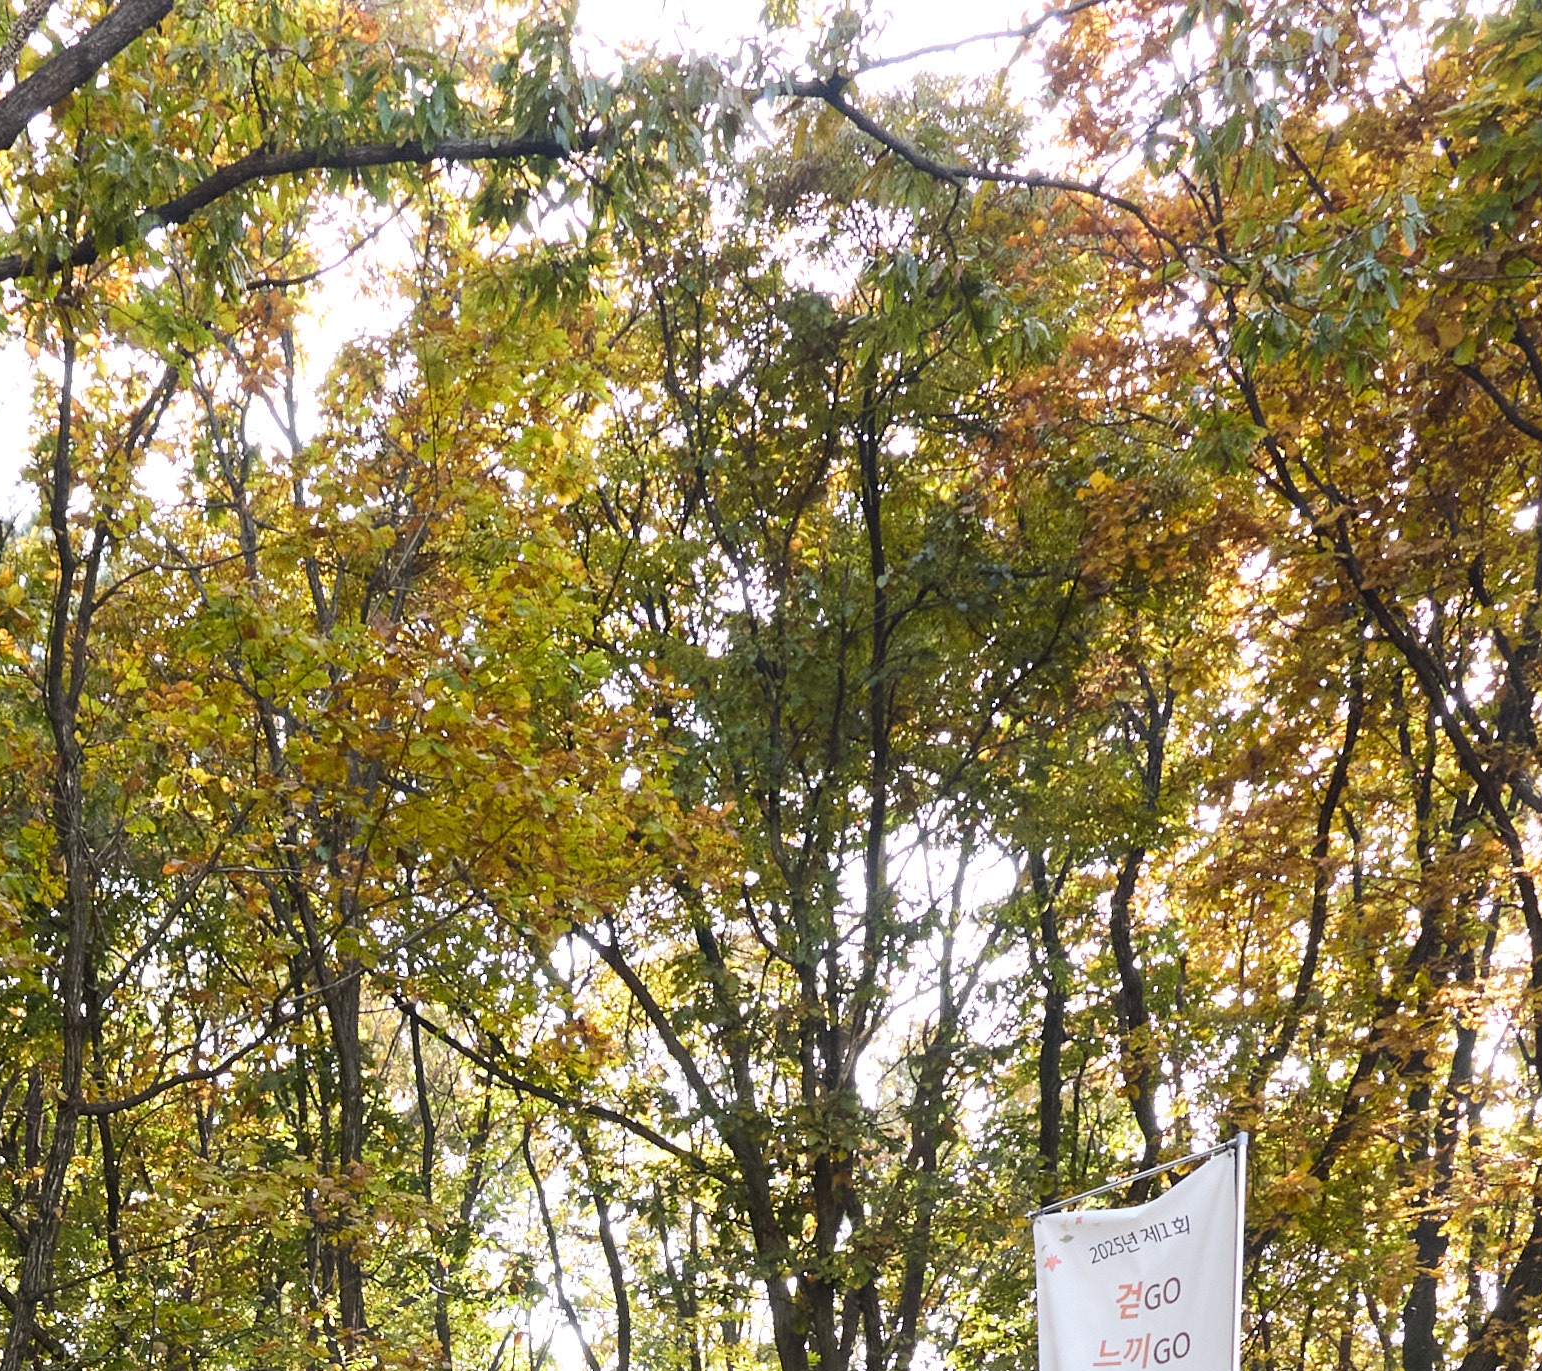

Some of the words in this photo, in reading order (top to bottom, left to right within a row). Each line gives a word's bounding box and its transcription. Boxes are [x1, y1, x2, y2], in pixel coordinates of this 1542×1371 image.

[1090, 1231, 1140, 1264] 2025년
[1140, 1214, 1191, 1243] 제1회
[1116, 1277, 1181, 1319] 걷GO
[1093, 1332, 1191, 1369] 느끼GO
